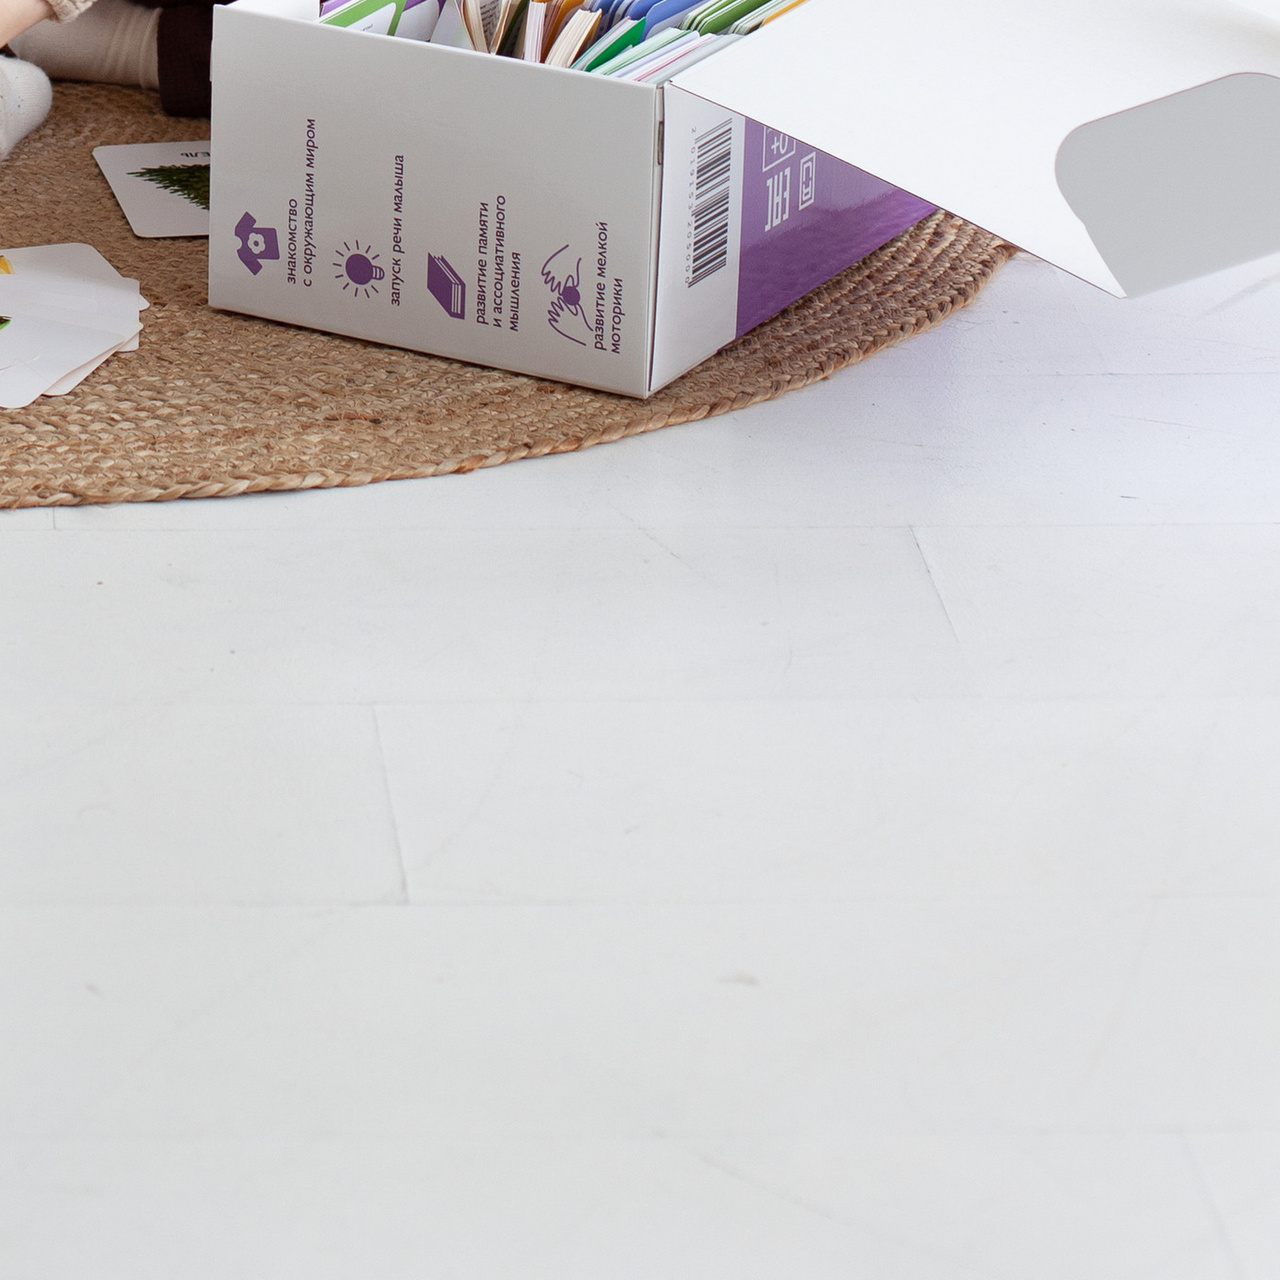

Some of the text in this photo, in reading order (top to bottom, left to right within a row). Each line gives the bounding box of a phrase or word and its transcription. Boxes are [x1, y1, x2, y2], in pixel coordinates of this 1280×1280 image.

[287, 198, 298, 284] знакомство
[303, 118, 318, 287] с окружающим миром
[391, 154, 405, 306] запуск речи малыша
[476, 202, 489, 326] развитие памяти
[493, 195, 506, 328] и ассоциативного
[510, 252, 521, 332] мышления
[594, 221, 608, 351] развитие мелкой
[611, 278, 625, 354] моторики
